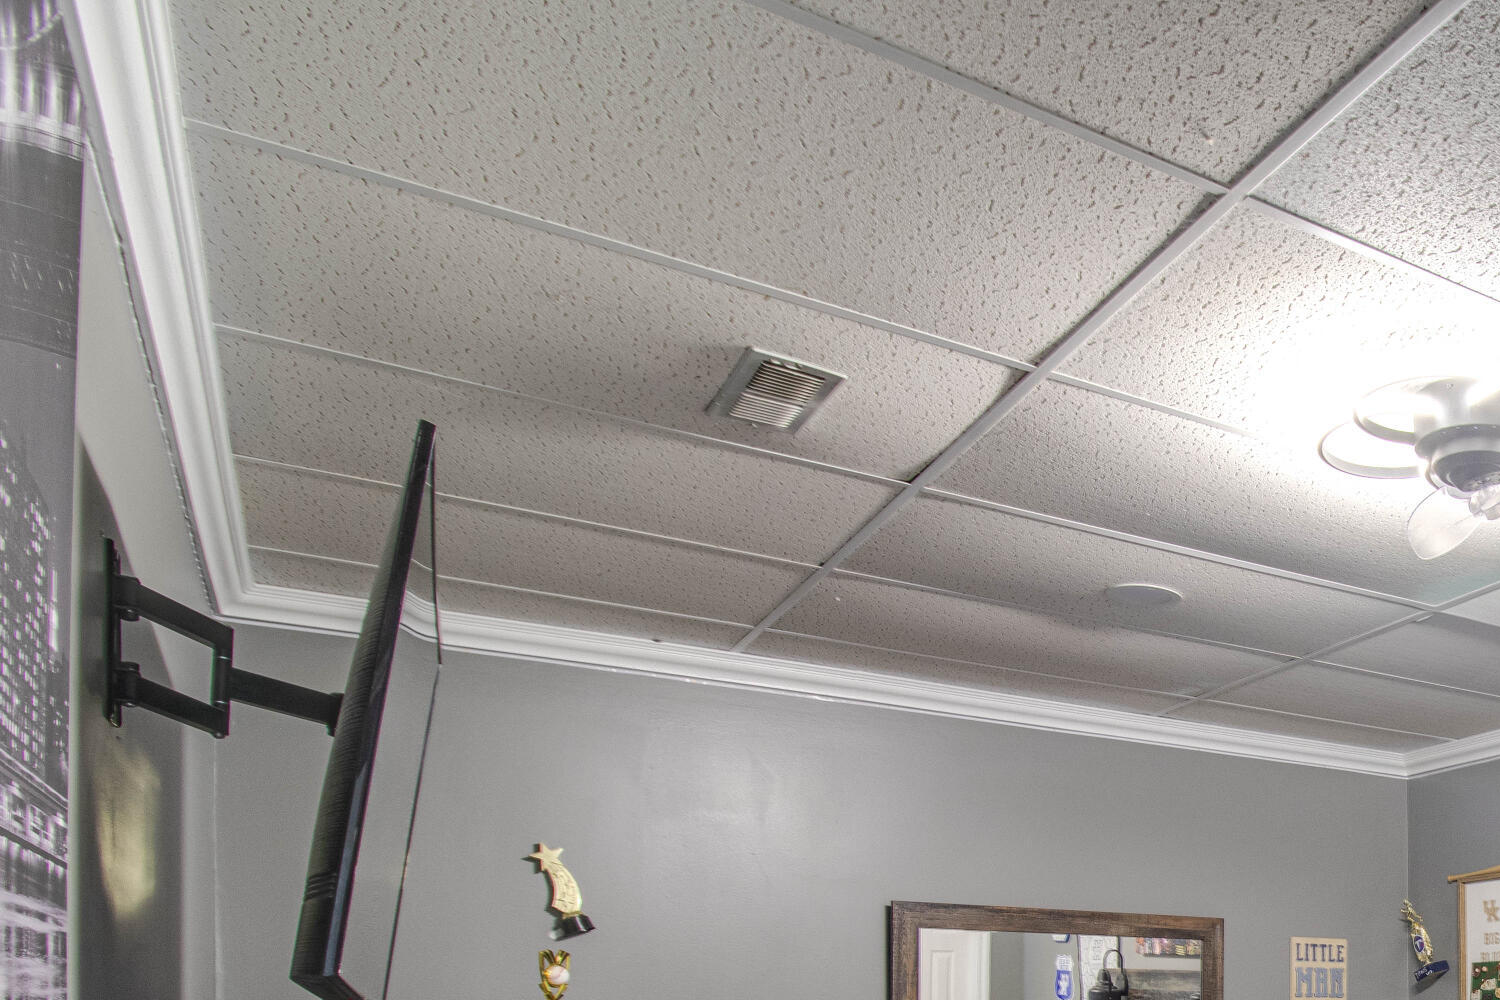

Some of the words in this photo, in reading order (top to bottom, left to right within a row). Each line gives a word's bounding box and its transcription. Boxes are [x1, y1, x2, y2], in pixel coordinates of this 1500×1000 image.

[1482, 899, 1500, 922] UK
[1295, 943, 1344, 962] LITTLE
[1295, 966, 1344, 998] MAN
